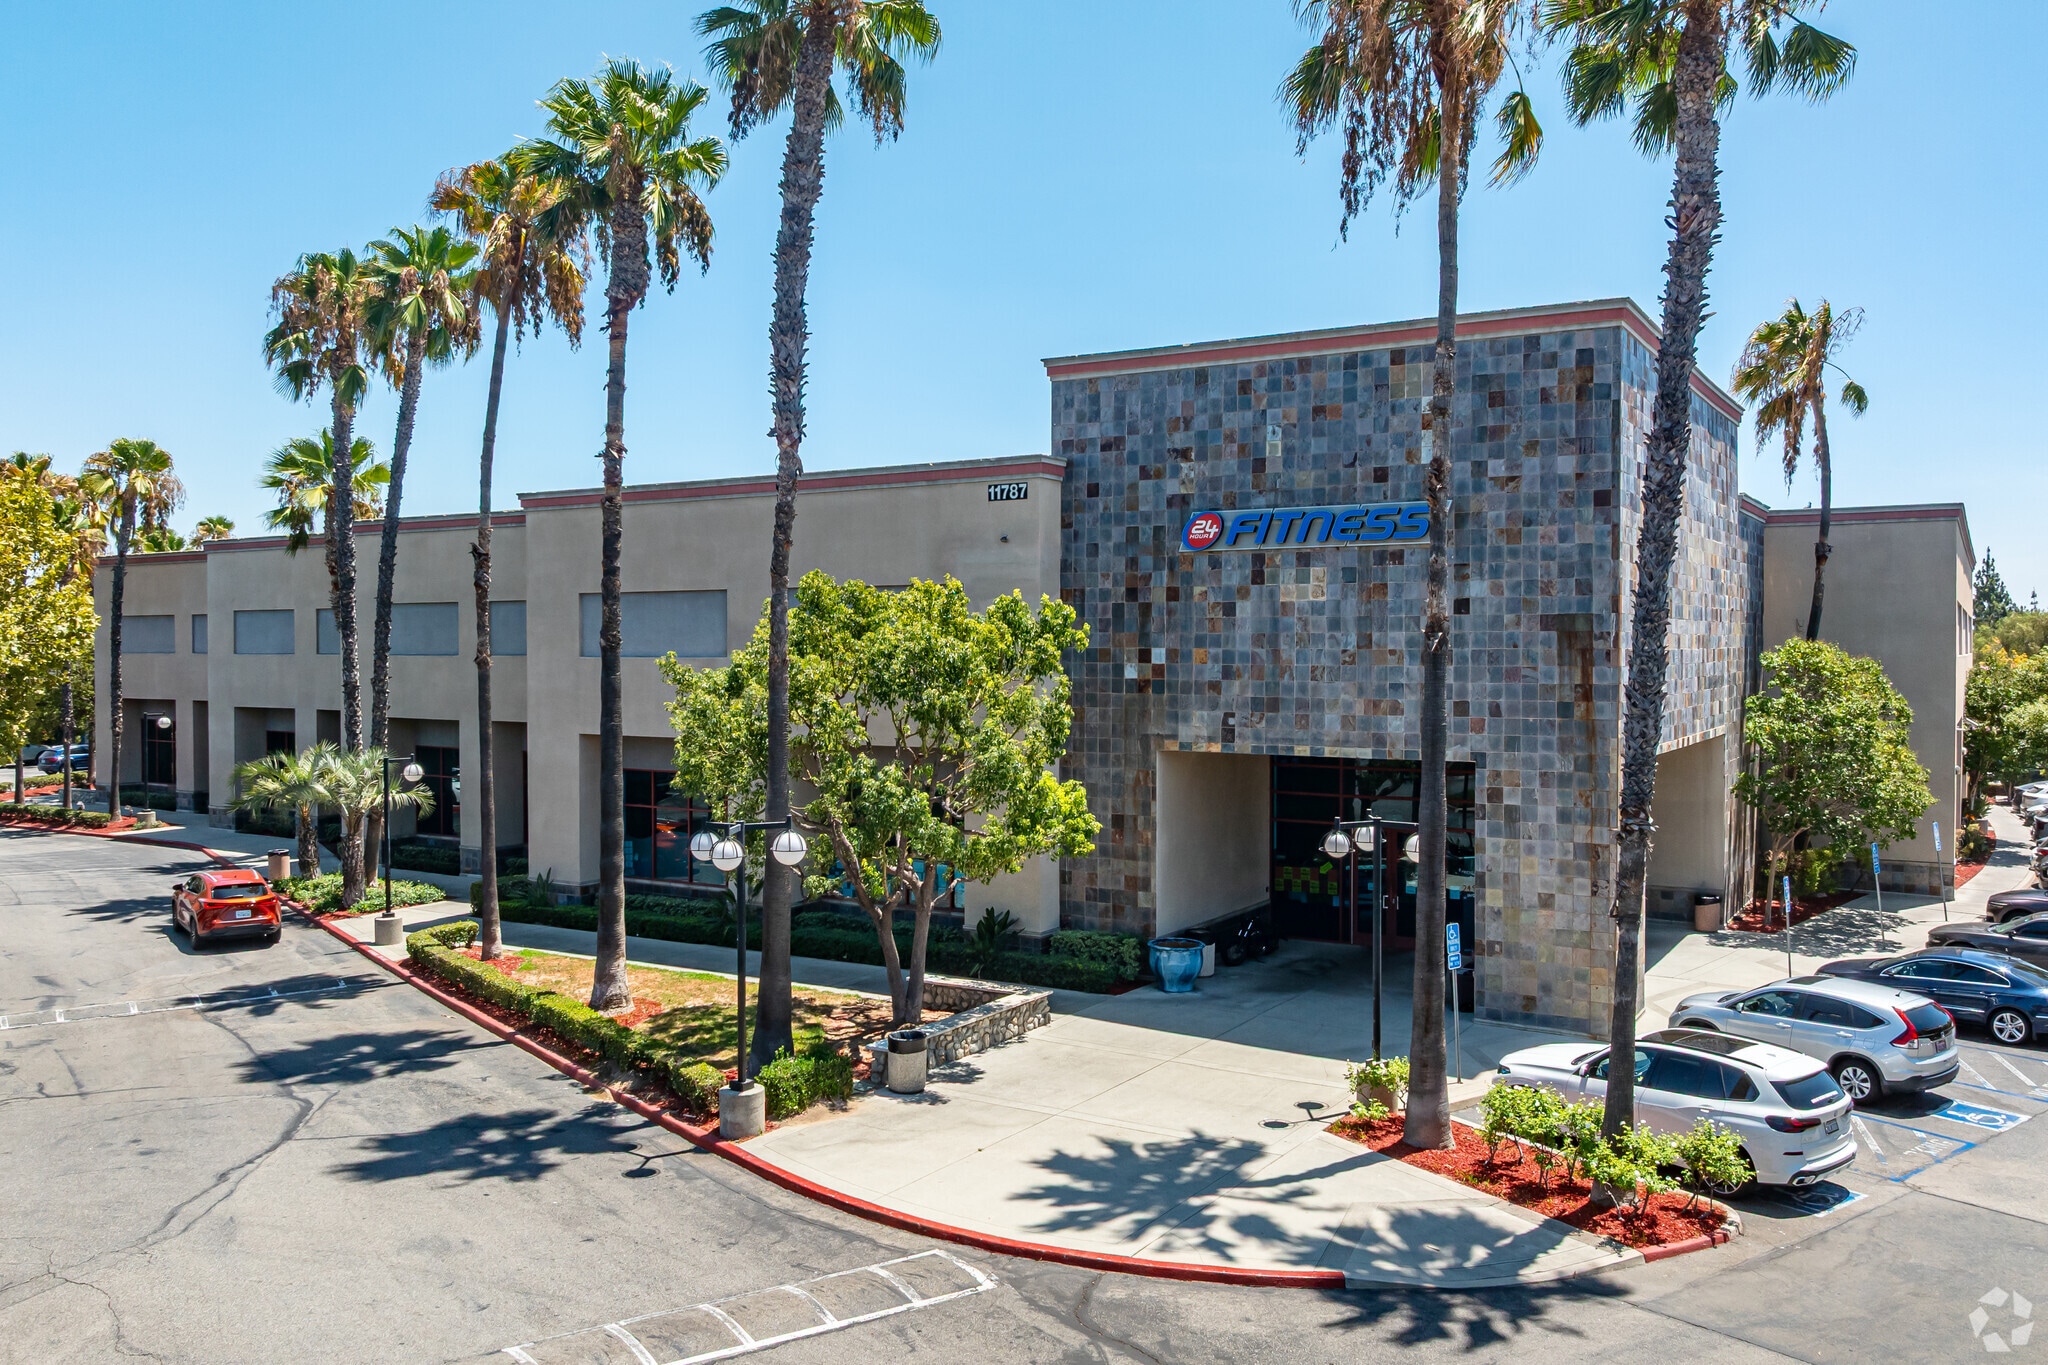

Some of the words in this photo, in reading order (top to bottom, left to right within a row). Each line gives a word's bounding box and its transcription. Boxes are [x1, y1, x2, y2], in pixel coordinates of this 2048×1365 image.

[988, 483, 1027, 500] 11787
[1191, 519, 1219, 539] 24
[1225, 505, 1430, 545] FITNESS
